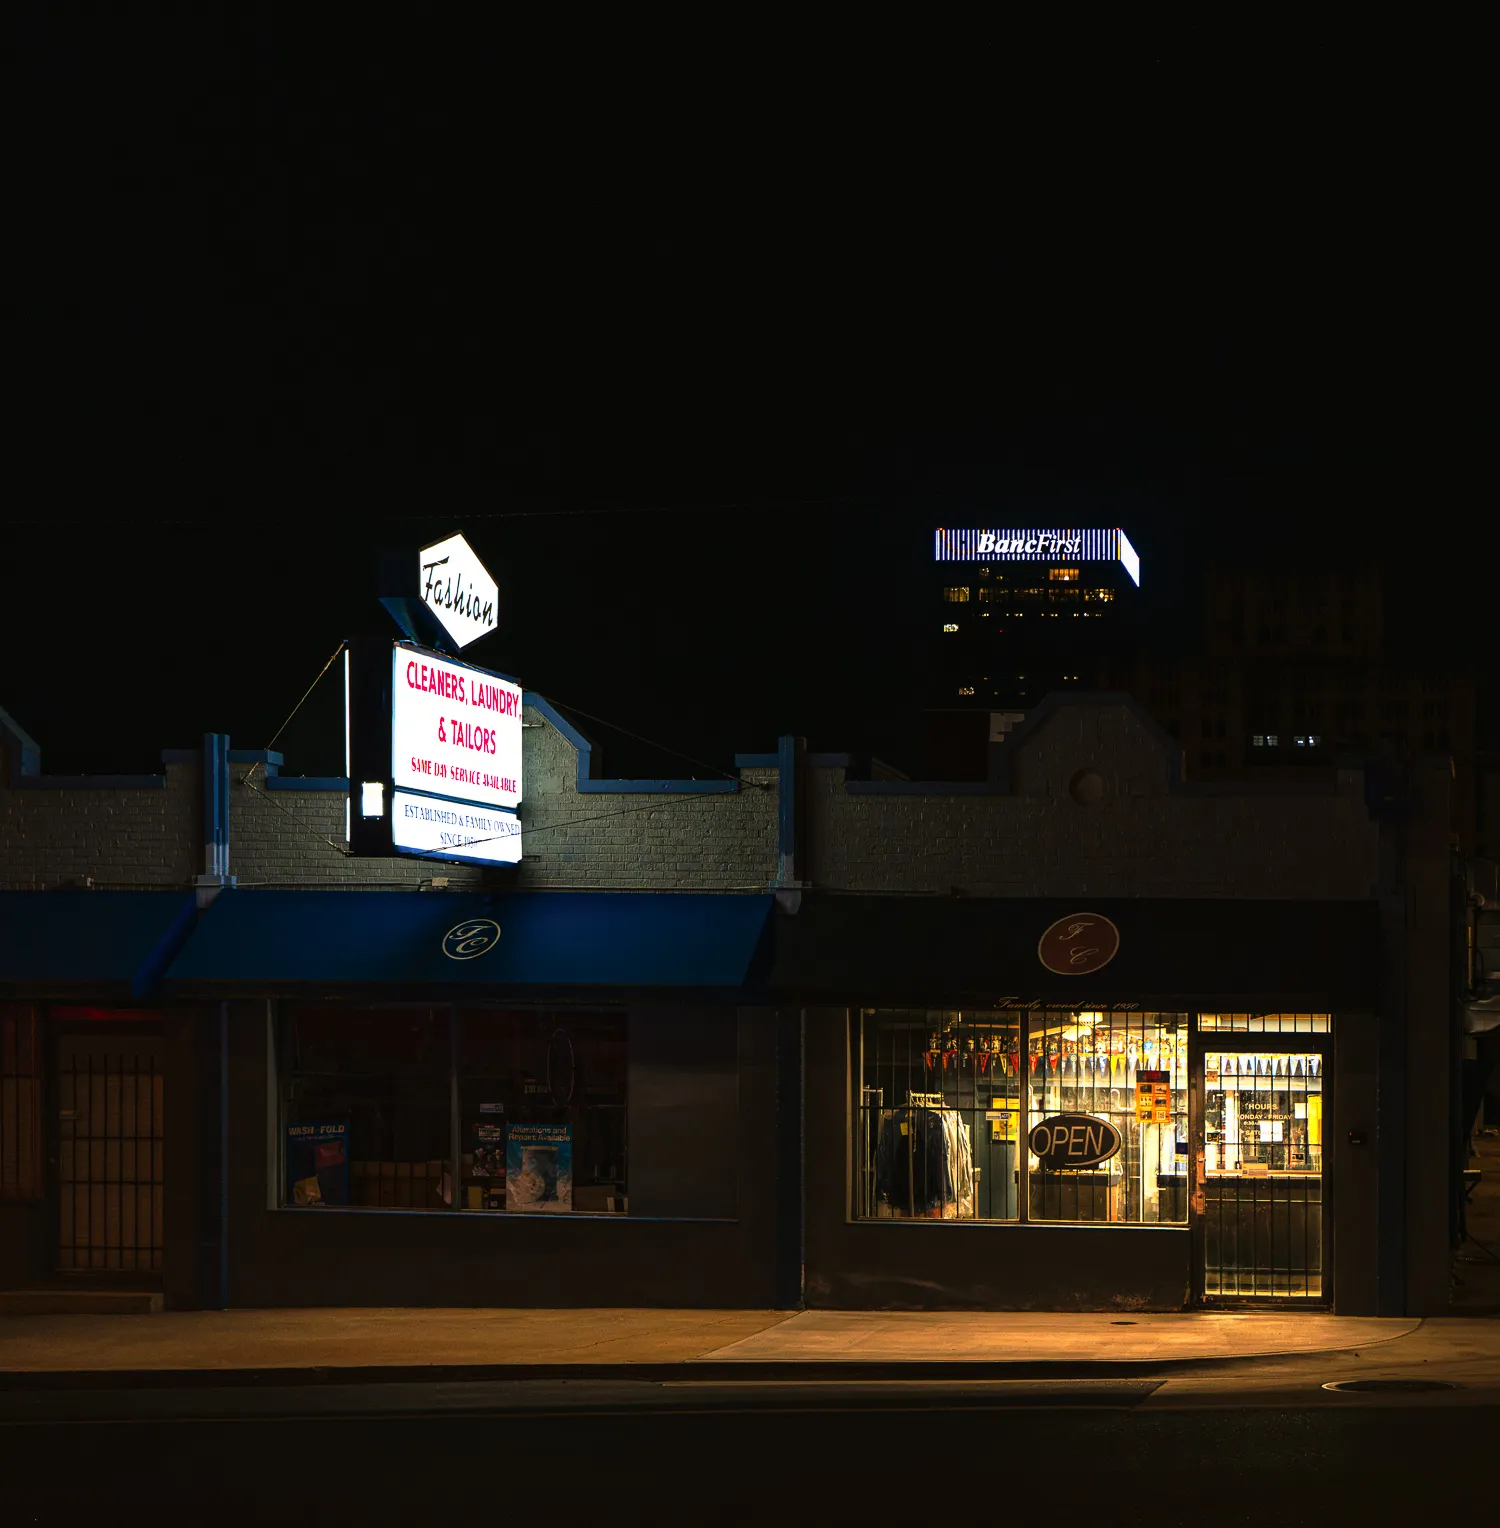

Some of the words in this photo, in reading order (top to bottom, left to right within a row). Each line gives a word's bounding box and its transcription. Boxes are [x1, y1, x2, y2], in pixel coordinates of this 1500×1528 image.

[977, 534, 1081, 554] BancFirst
[423, 556, 493, 627] Fashion
[407, 661, 468, 705] CLEANERS,
[438, 717, 446, 742] &
[451, 720, 496, 754] TAILORS
[411, 757, 431, 775] SAME
[434, 762, 447, 778] DAY
[450, 766, 480, 785] SERVICE
[483, 774, 516, 793] AVAILABLE
[405, 805, 457, 825] ESTABLISHED
[459, 816, 464, 827] &
[466, 816, 492, 831] FAMILY
[494, 821, 520, 836] OWNED
[440, 832, 461, 847] SINCE
[994, 996, 1041, 1010] Family
[1046, 1000, 1085, 1009] owned
[1083, 1001, 1107, 1009] since
[289, 1126, 315, 1136] WASH
[320, 1125, 345, 1134] FOLD
[511, 1126, 551, 1134] Alterations
[552, 1126, 567, 1134] and
[1032, 1126, 1104, 1155] OPEN
